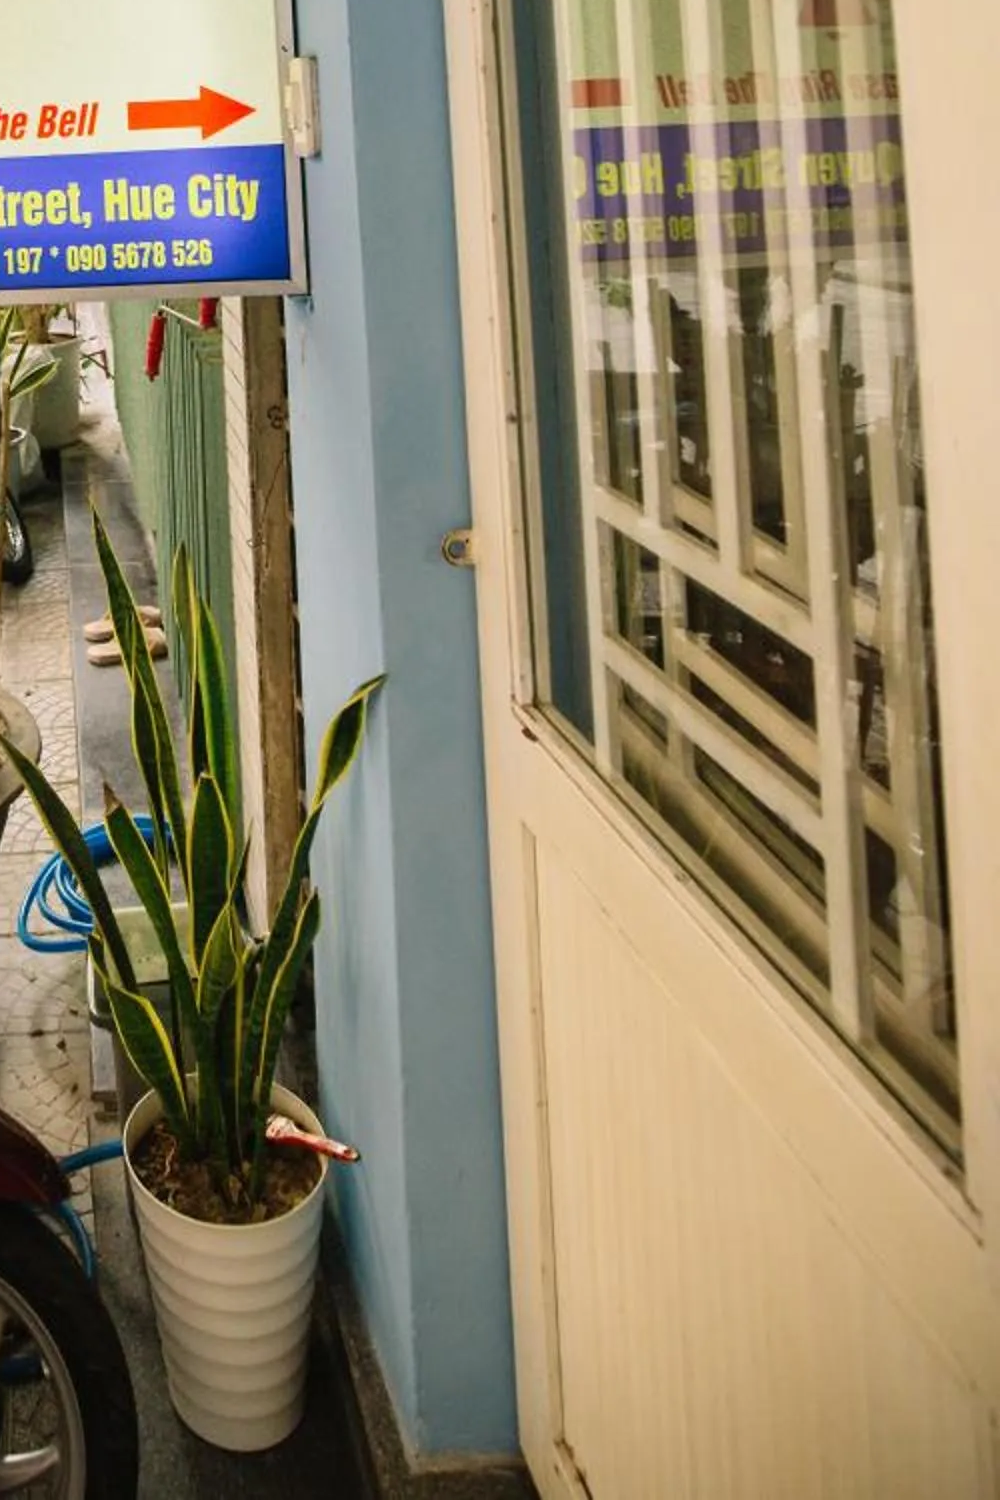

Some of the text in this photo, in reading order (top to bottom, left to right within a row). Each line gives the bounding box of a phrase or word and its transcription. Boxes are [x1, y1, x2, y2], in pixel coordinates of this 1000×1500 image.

[36, 102, 99, 140] Bell
[102, 178, 176, 223] Hue
[186, 172, 260, 222] City
[3, 246, 44, 276] 197
[65, 243, 107, 273] 090
[112, 241, 167, 270] 5678
[171, 238, 213, 267] 526
